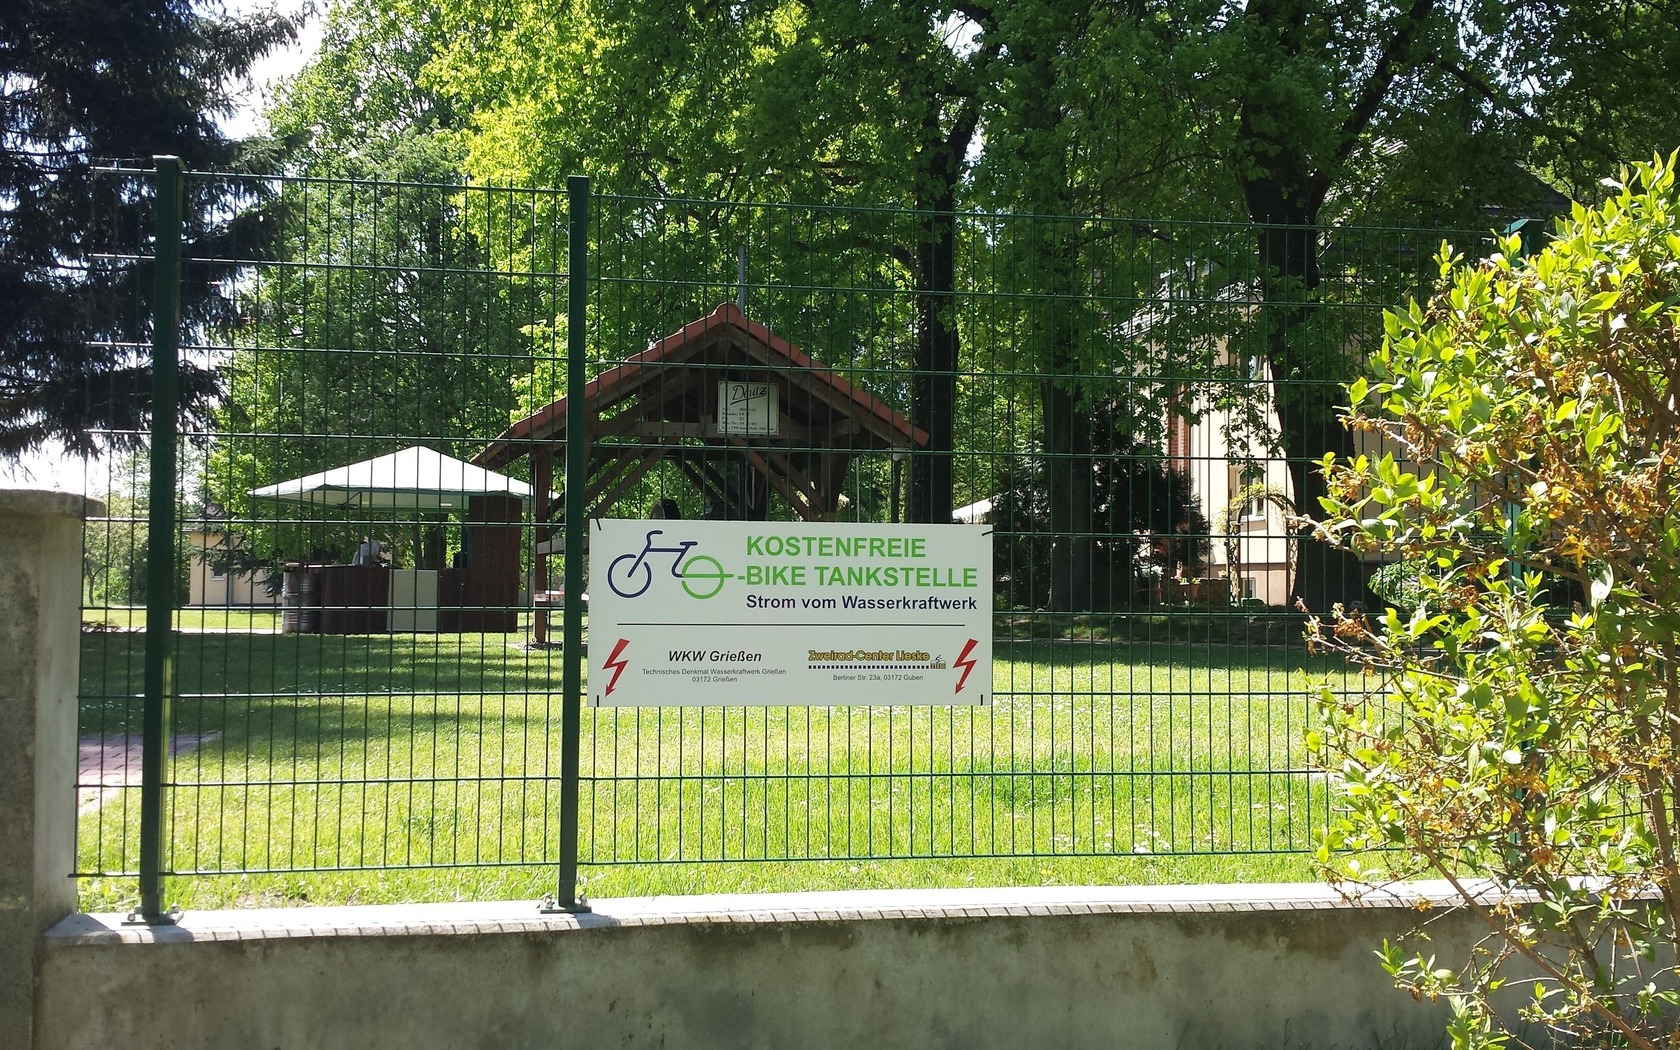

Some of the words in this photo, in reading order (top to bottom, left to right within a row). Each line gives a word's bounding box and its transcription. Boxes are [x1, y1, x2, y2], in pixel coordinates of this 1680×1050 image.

[746, 535, 926, 558] KOSTENFREIE
[814, 566, 978, 588] TANKSTELLE
[746, 594, 796, 609] Strom
[801, 598, 837, 609] vom
[841, 595, 978, 610] Wasserkraftwerk
[668, 650, 706, 662] WKW
[709, 650, 762, 662] Grießen
[807, 649, 895, 662] Zweirad-Center
[895, 649, 931, 662] Lieske
[868, 674, 883, 682] 23a,
